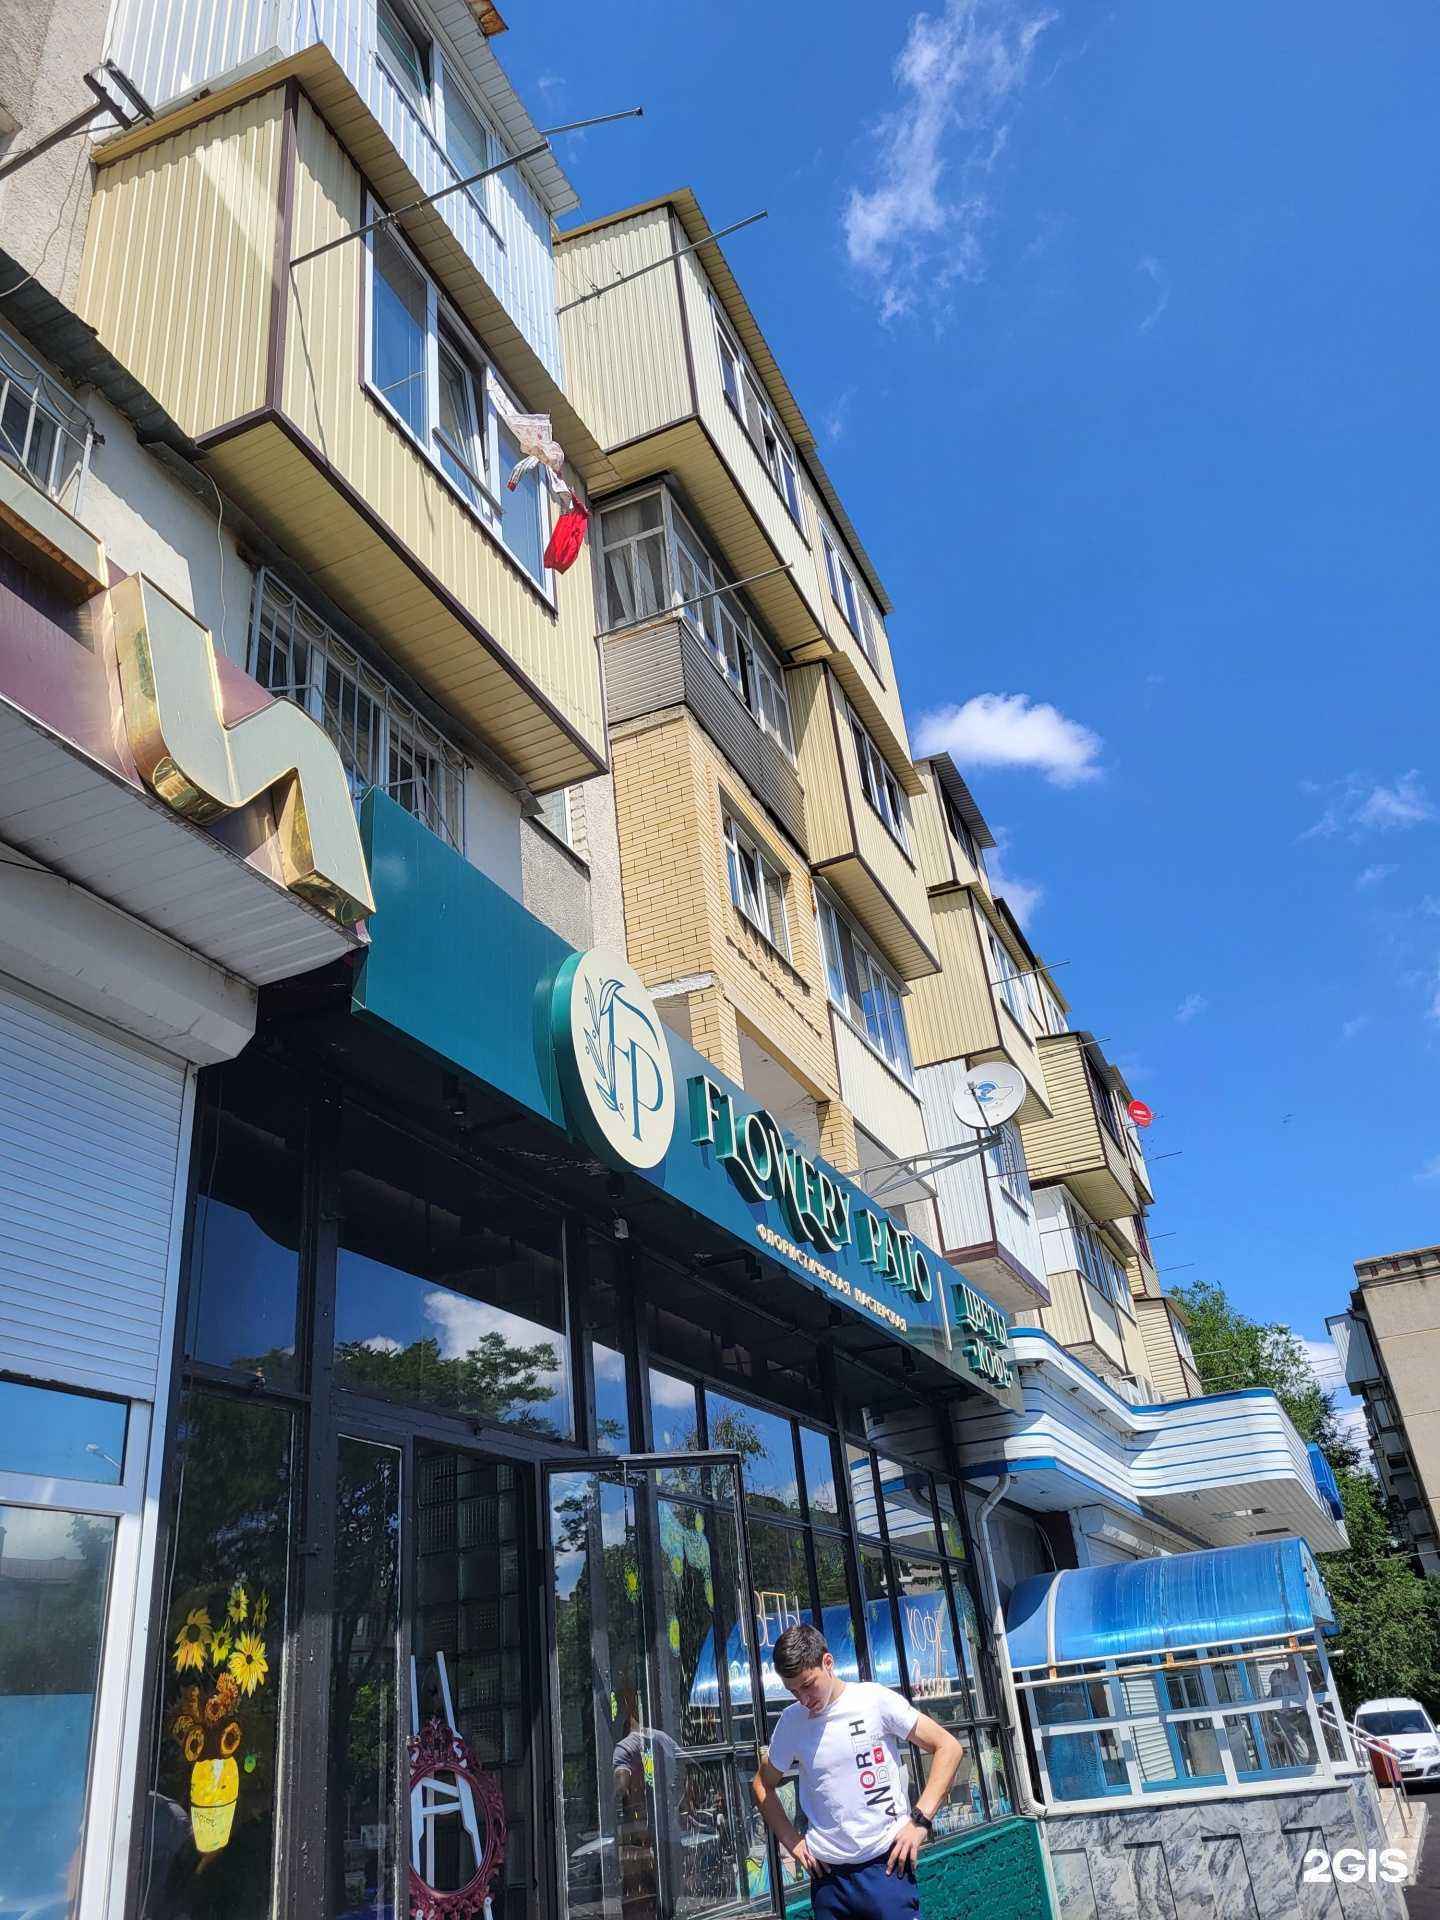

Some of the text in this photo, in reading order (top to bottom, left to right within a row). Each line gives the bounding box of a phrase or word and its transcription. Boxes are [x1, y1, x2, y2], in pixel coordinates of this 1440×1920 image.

[700, 1074, 933, 1302] FLOWERY PATIO
[958, 1282, 1009, 1349] ЦВЕТЫ
